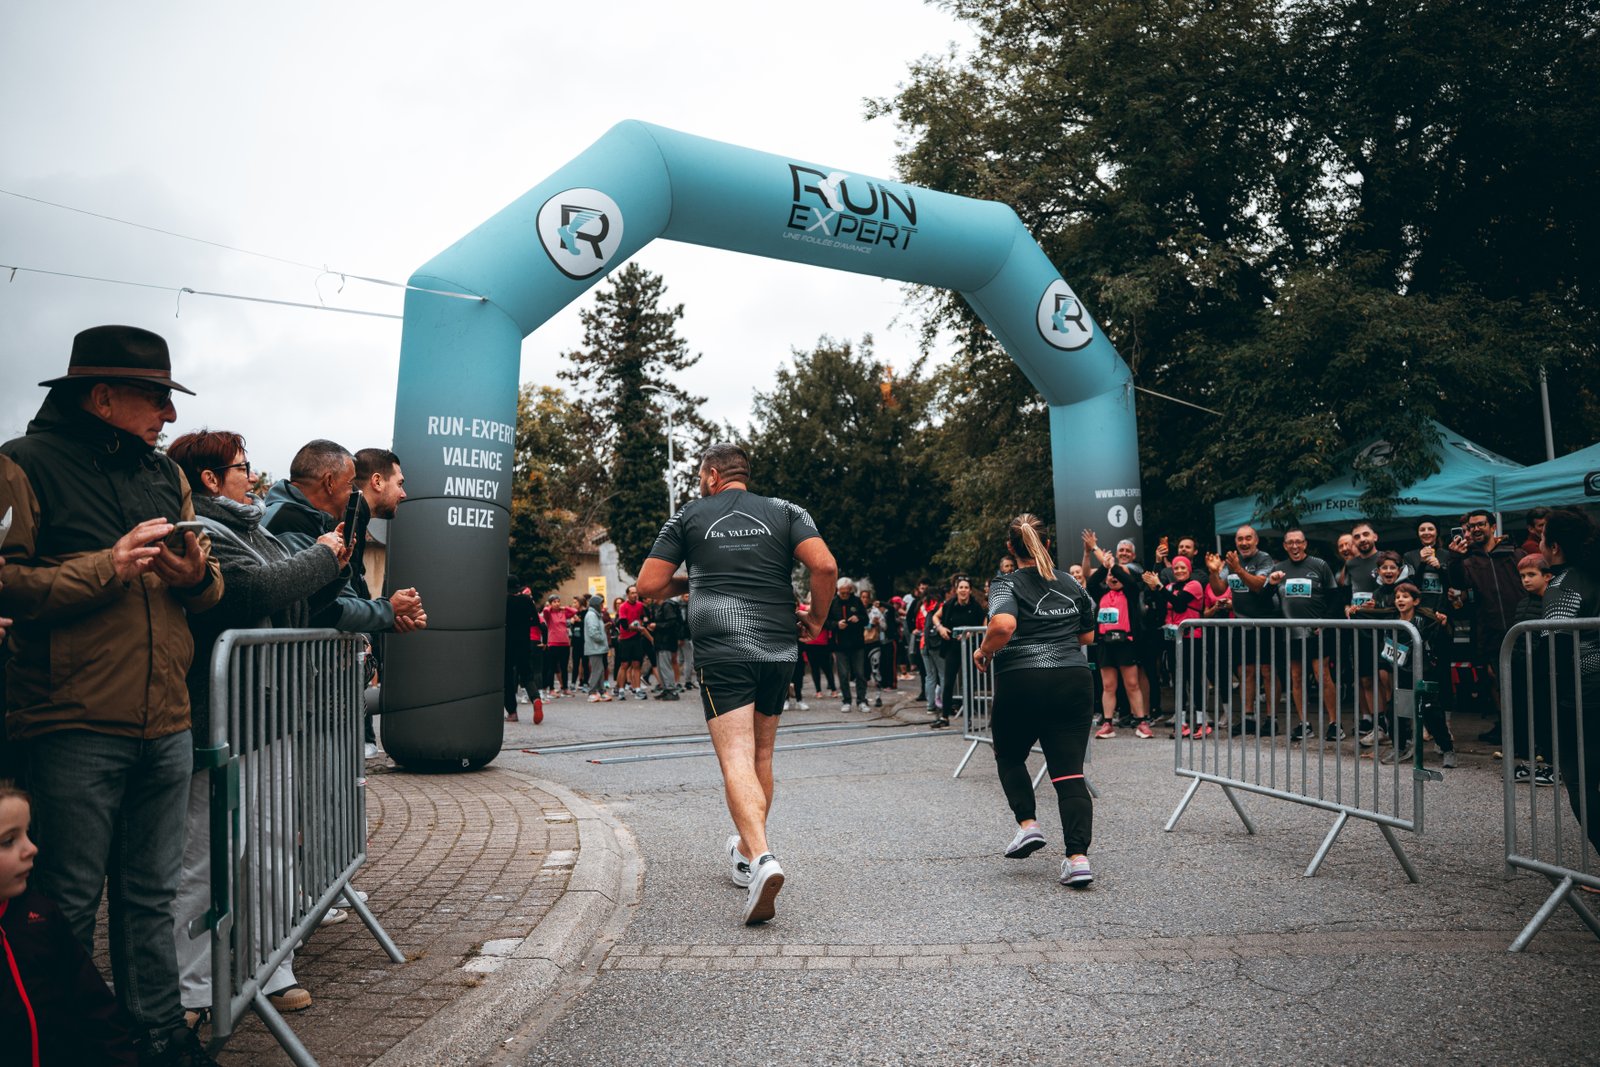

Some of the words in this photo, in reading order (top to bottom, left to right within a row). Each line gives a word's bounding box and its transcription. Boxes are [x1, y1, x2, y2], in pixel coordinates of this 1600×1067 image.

[788, 163, 917, 226] RUN
[787, 203, 918, 250] EXPERT
[783, 231, 801, 241] UNE
[427, 416, 514, 445] RUN-EXPERT
[443, 447, 503, 471] VALENCE
[444, 476, 499, 500] ANNECY
[447, 506, 495, 529] GLEIZE
[710, 530, 726, 538] Ets.
[728, 528, 765, 537] VALLON
[1291, 584, 1305, 593] 88
[1423, 580, 1436, 589] 94
[1049, 607, 1076, 615] VALLON
[1102, 613, 1112, 621] 81
